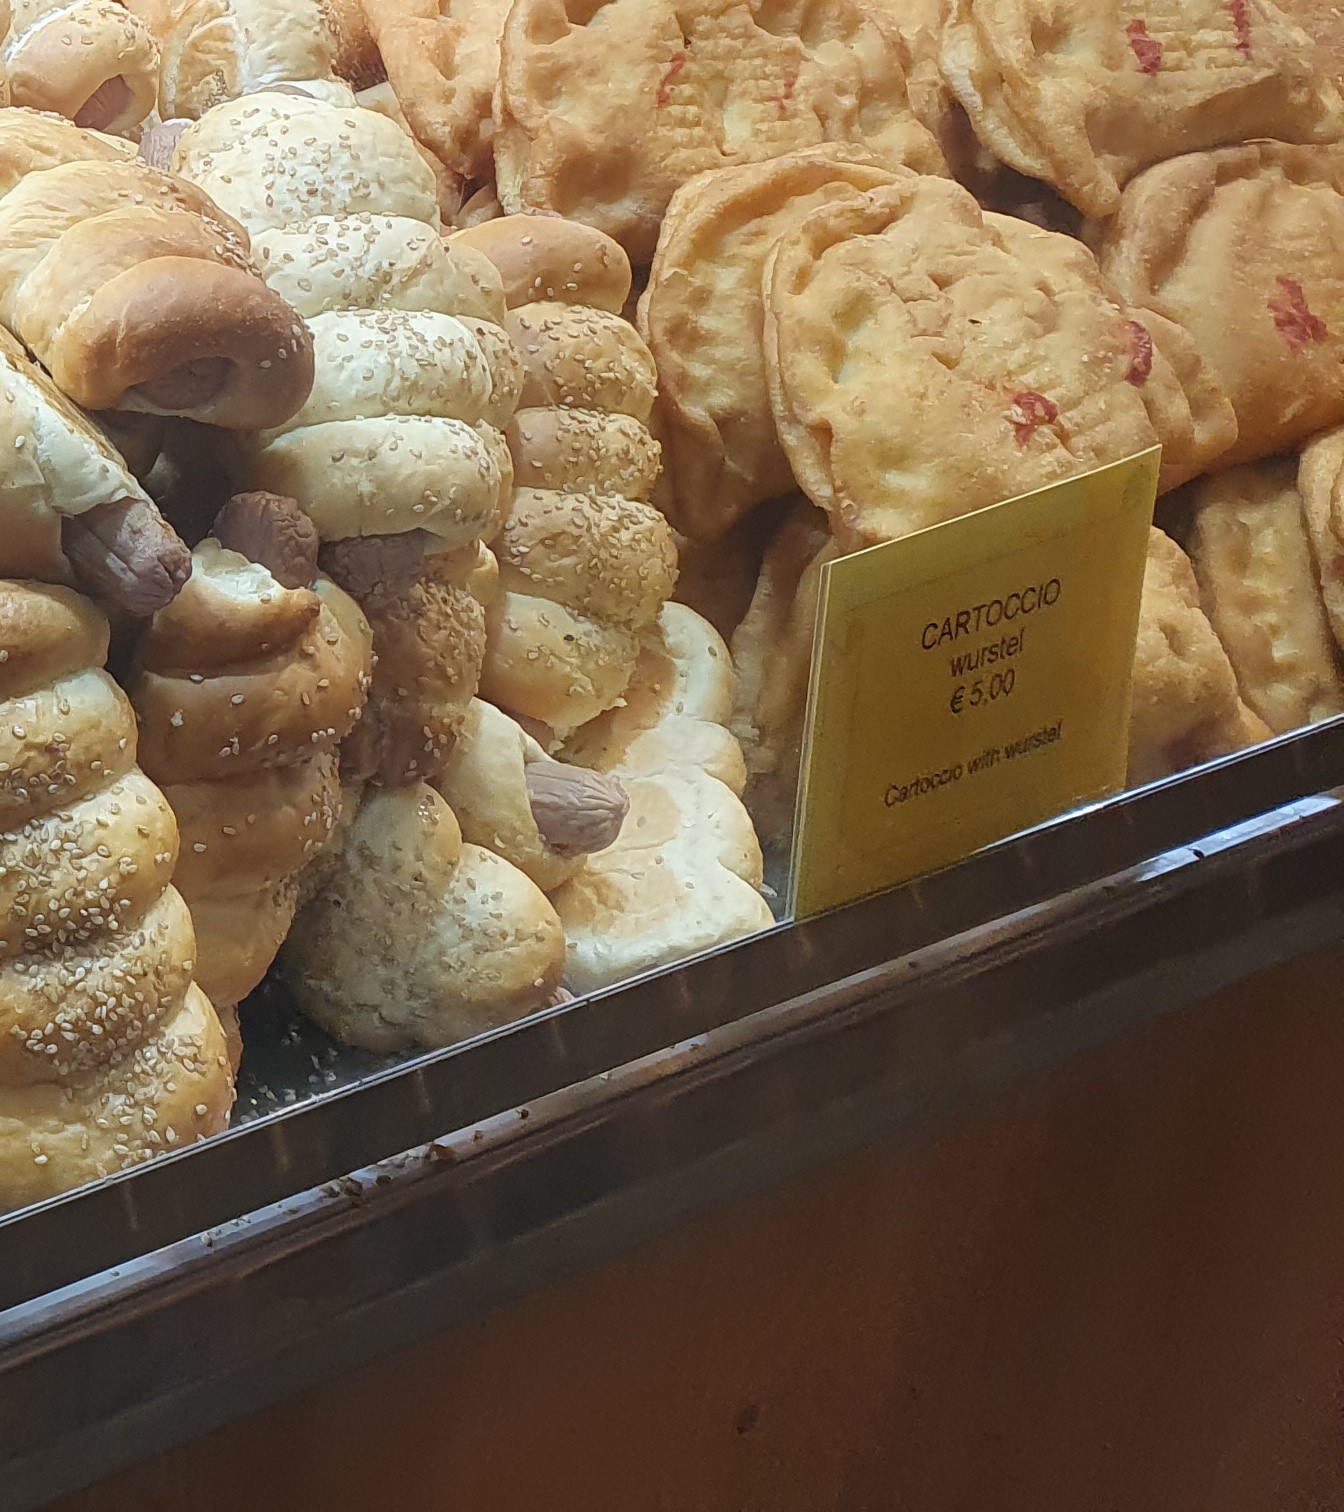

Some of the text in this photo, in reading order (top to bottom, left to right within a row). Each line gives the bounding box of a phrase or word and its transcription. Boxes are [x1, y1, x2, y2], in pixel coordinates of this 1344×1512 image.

[921, 578, 1061, 650] CARTOCCIO
[950, 626, 1026, 678] wurstel
[950, 668, 1015, 714] € 5,00
[883, 718, 1063, 808] Cartoccio with wurstel
